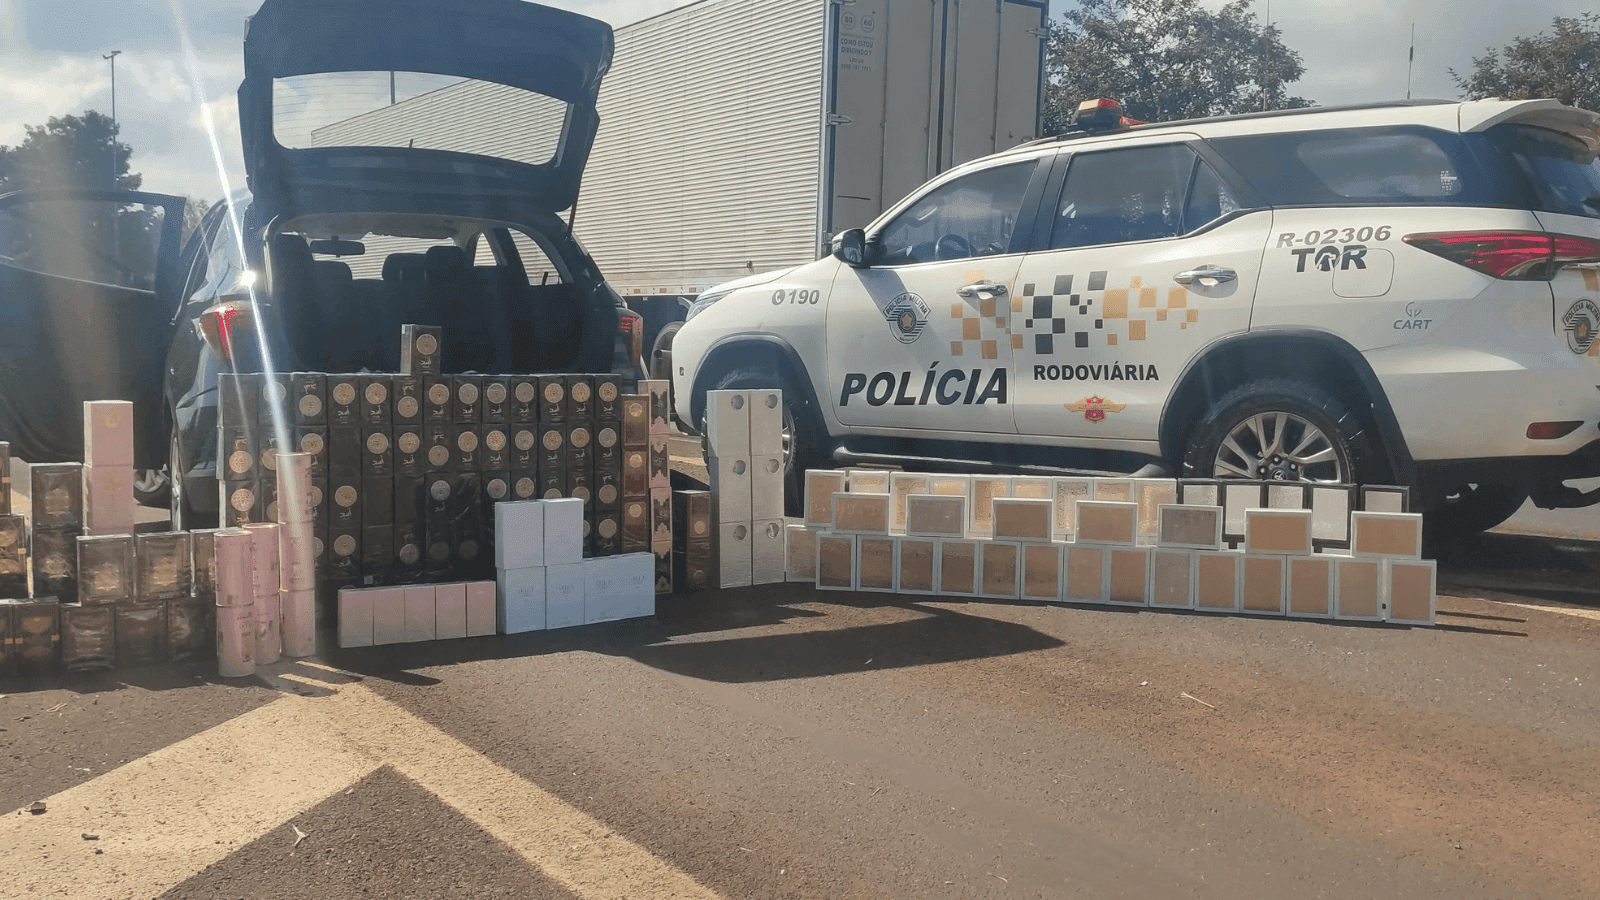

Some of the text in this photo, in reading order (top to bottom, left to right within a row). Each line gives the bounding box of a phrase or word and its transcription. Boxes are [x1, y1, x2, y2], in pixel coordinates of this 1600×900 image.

[840, 38, 874, 48] COMO ESTOU
[1276, 225, 1392, 248] R-02306
[1291, 244, 1368, 272] TOR
[788, 289, 820, 304] 190
[909, 294, 928, 315] MILITAR
[1393, 319, 1432, 330] CART
[1033, 360, 1160, 381] RODOVIÁRIA
[838, 360, 1008, 406] POLÍCIA
